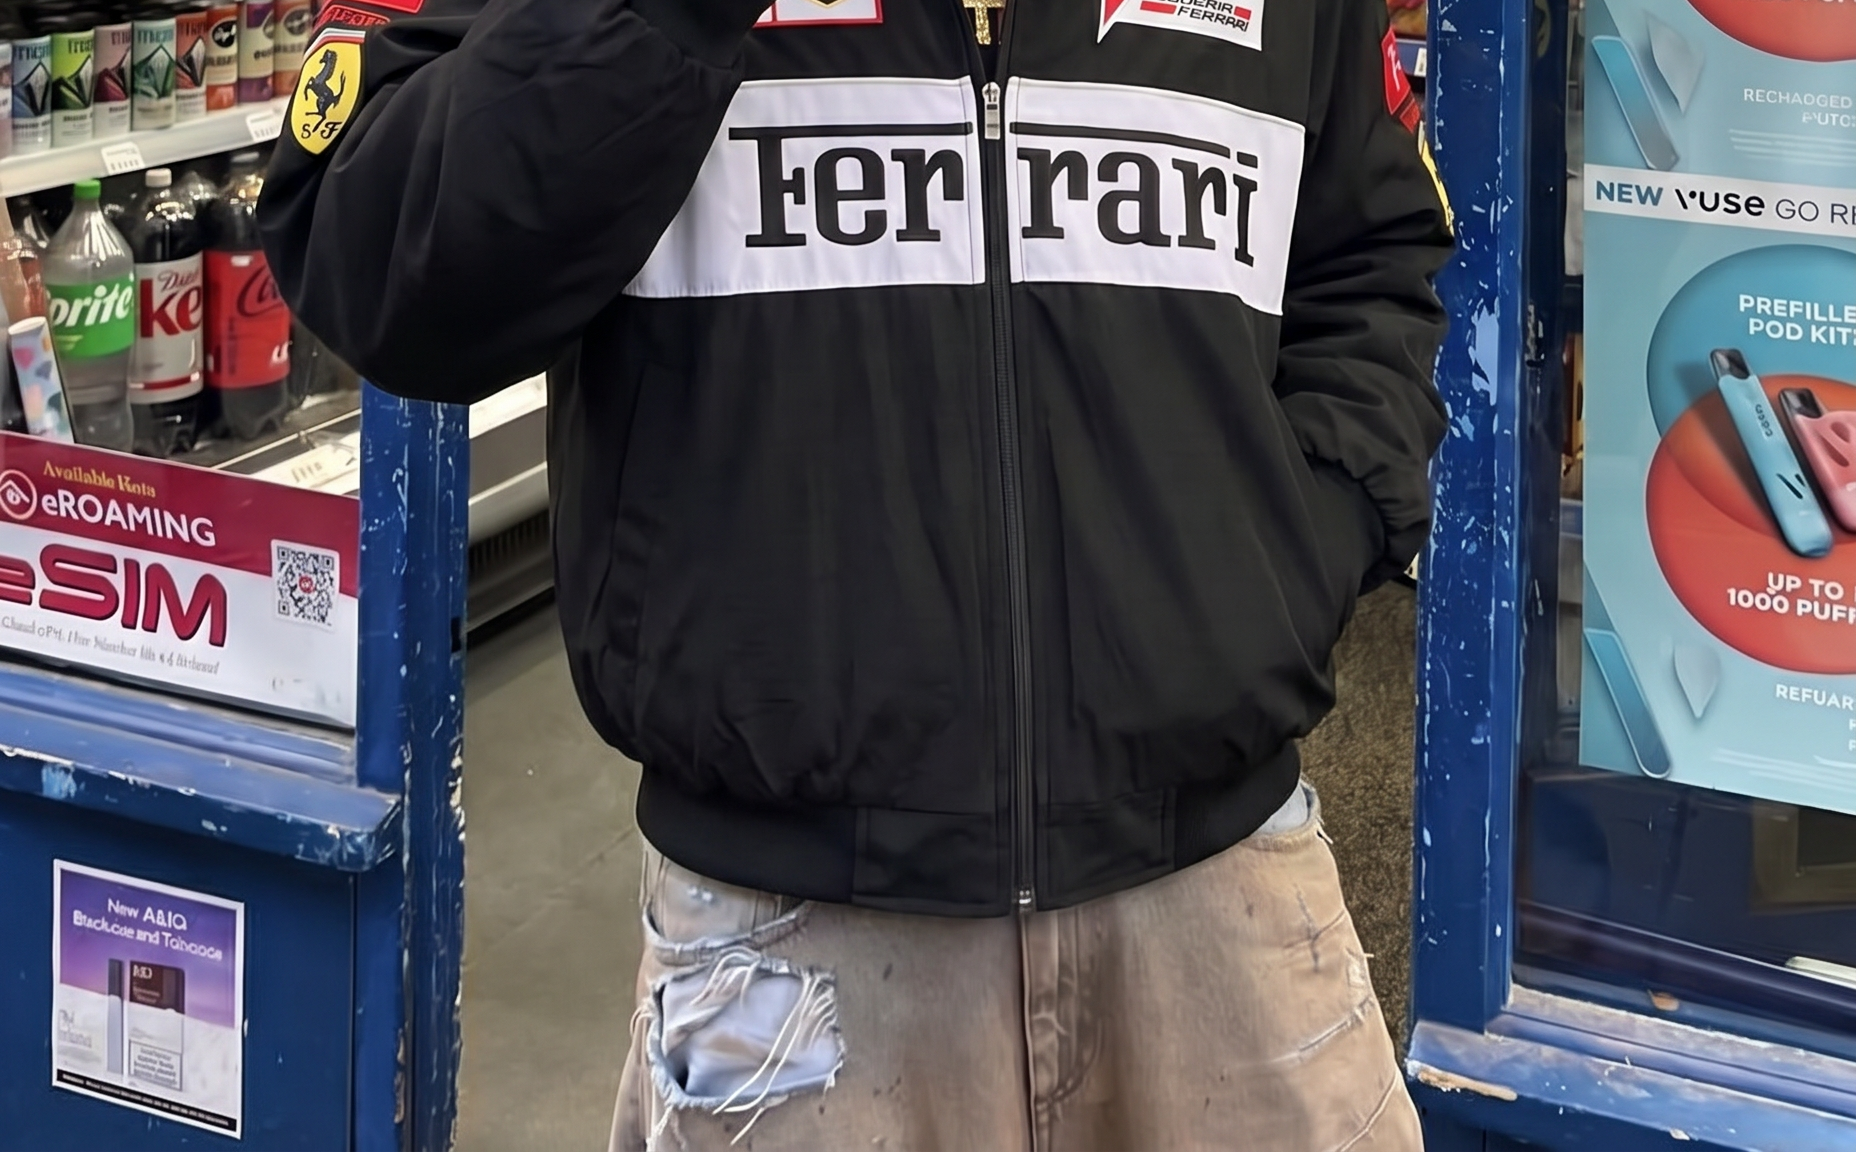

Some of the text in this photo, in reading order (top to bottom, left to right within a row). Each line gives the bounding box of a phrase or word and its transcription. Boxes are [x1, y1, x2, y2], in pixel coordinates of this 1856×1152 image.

[1596, 180, 1663, 206] NEW
[1775, 199, 1820, 222] GO
[48, 282, 134, 328] prite
[1748, 318, 1803, 341] POD
[41, 489, 216, 547] eROAMING
[1727, 587, 1790, 614] 1000
[1768, 571, 1845, 601] UP TO
